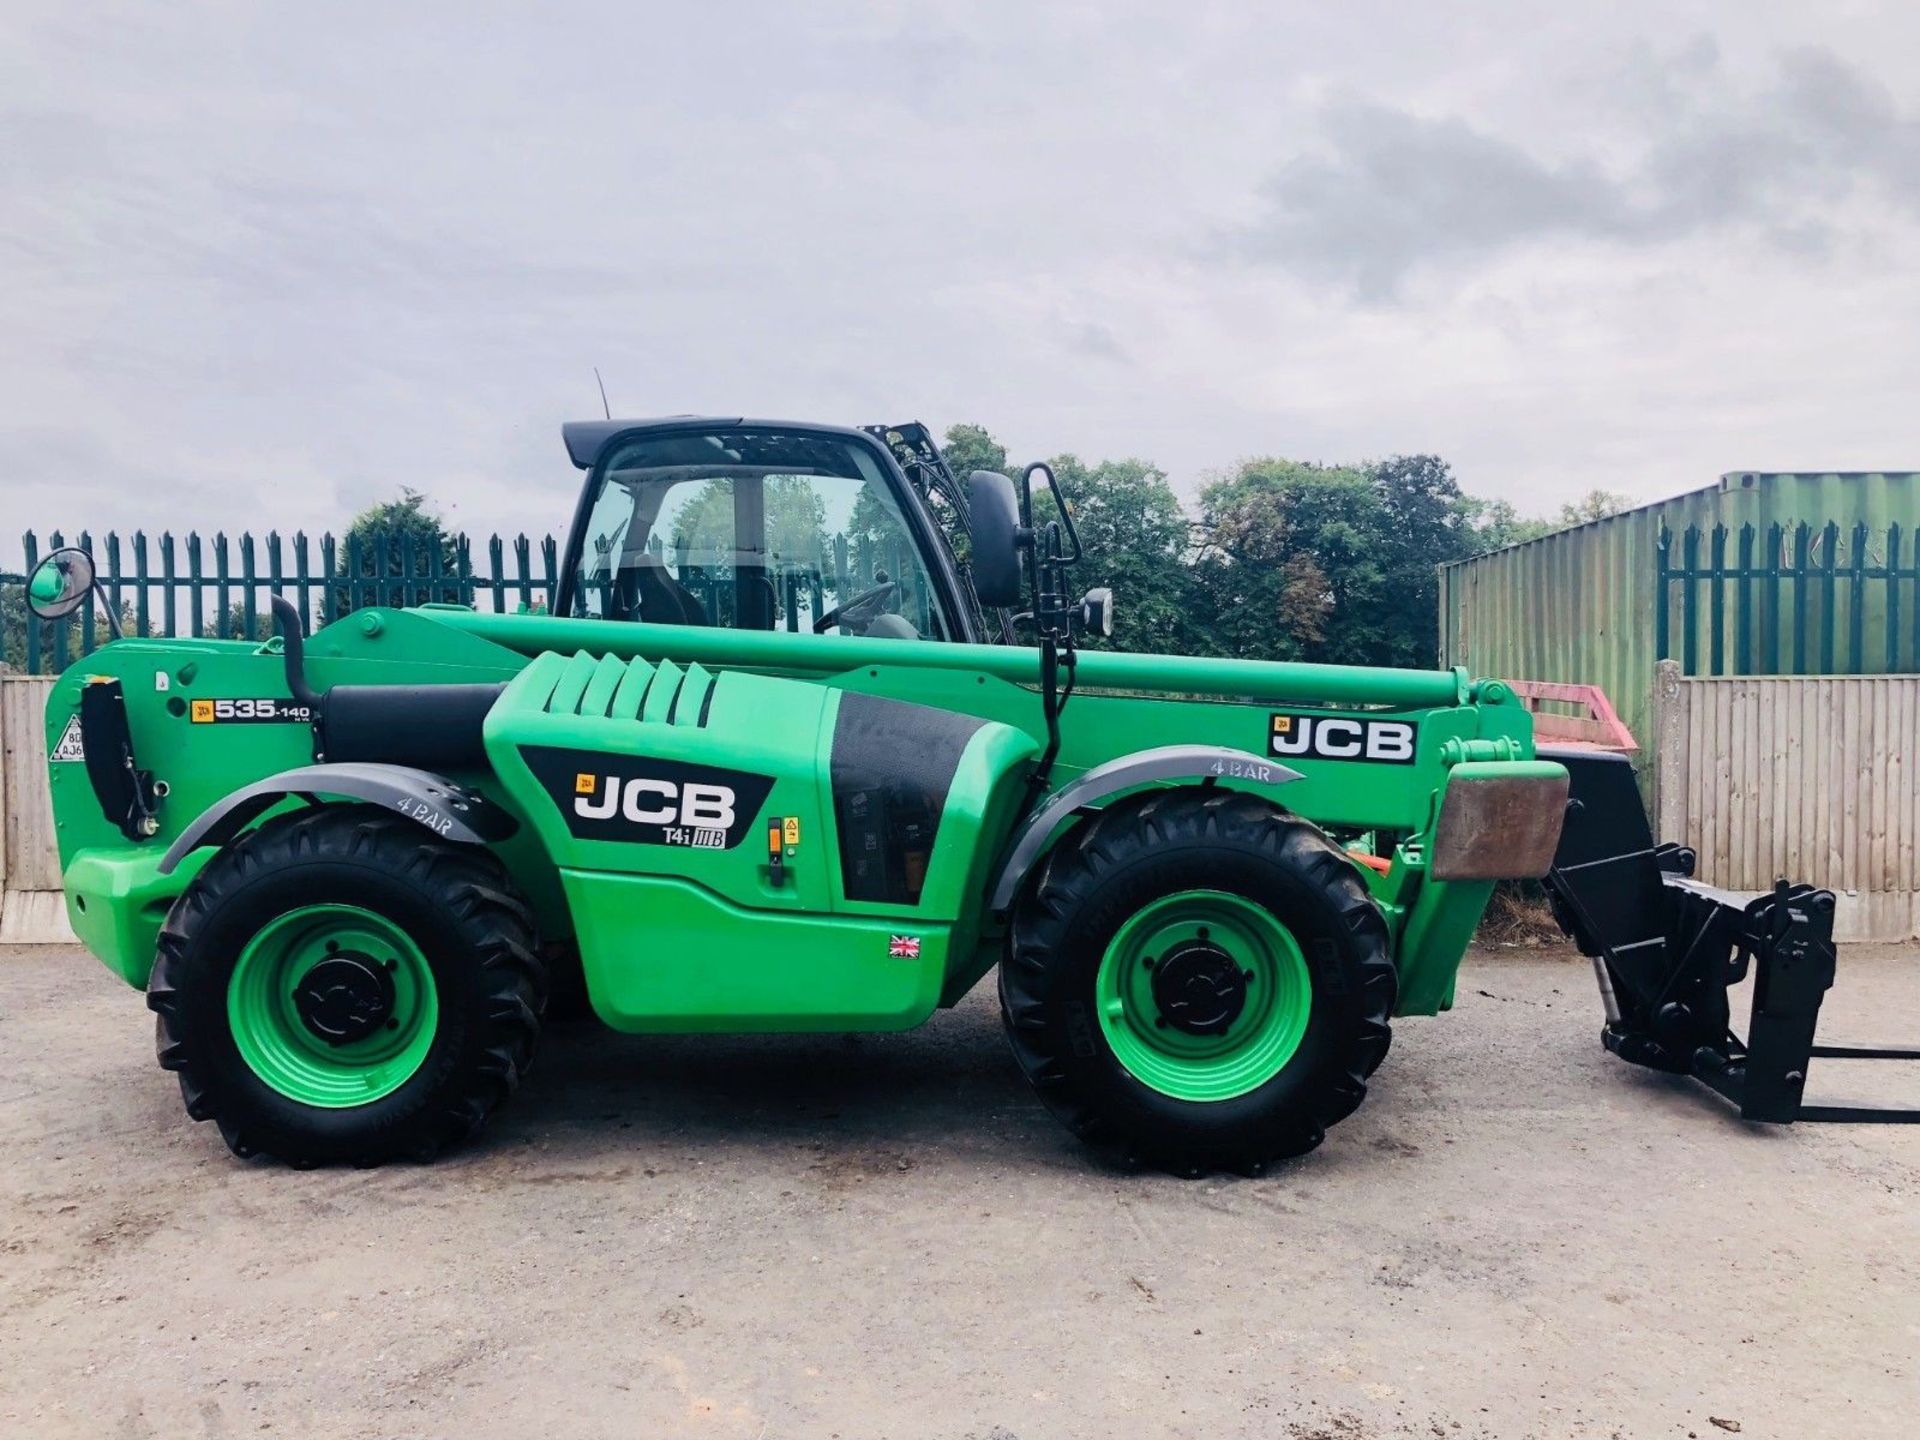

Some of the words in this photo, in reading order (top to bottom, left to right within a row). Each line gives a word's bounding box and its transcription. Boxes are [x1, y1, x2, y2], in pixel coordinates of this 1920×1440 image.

[1272, 717, 1414, 760] JCB
[1210, 759, 1224, 775] 4
[1229, 763, 1271, 782] BAR
[397, 797, 413, 811] 4
[412, 803, 452, 835] BAR
[574, 776, 736, 829] JCB
